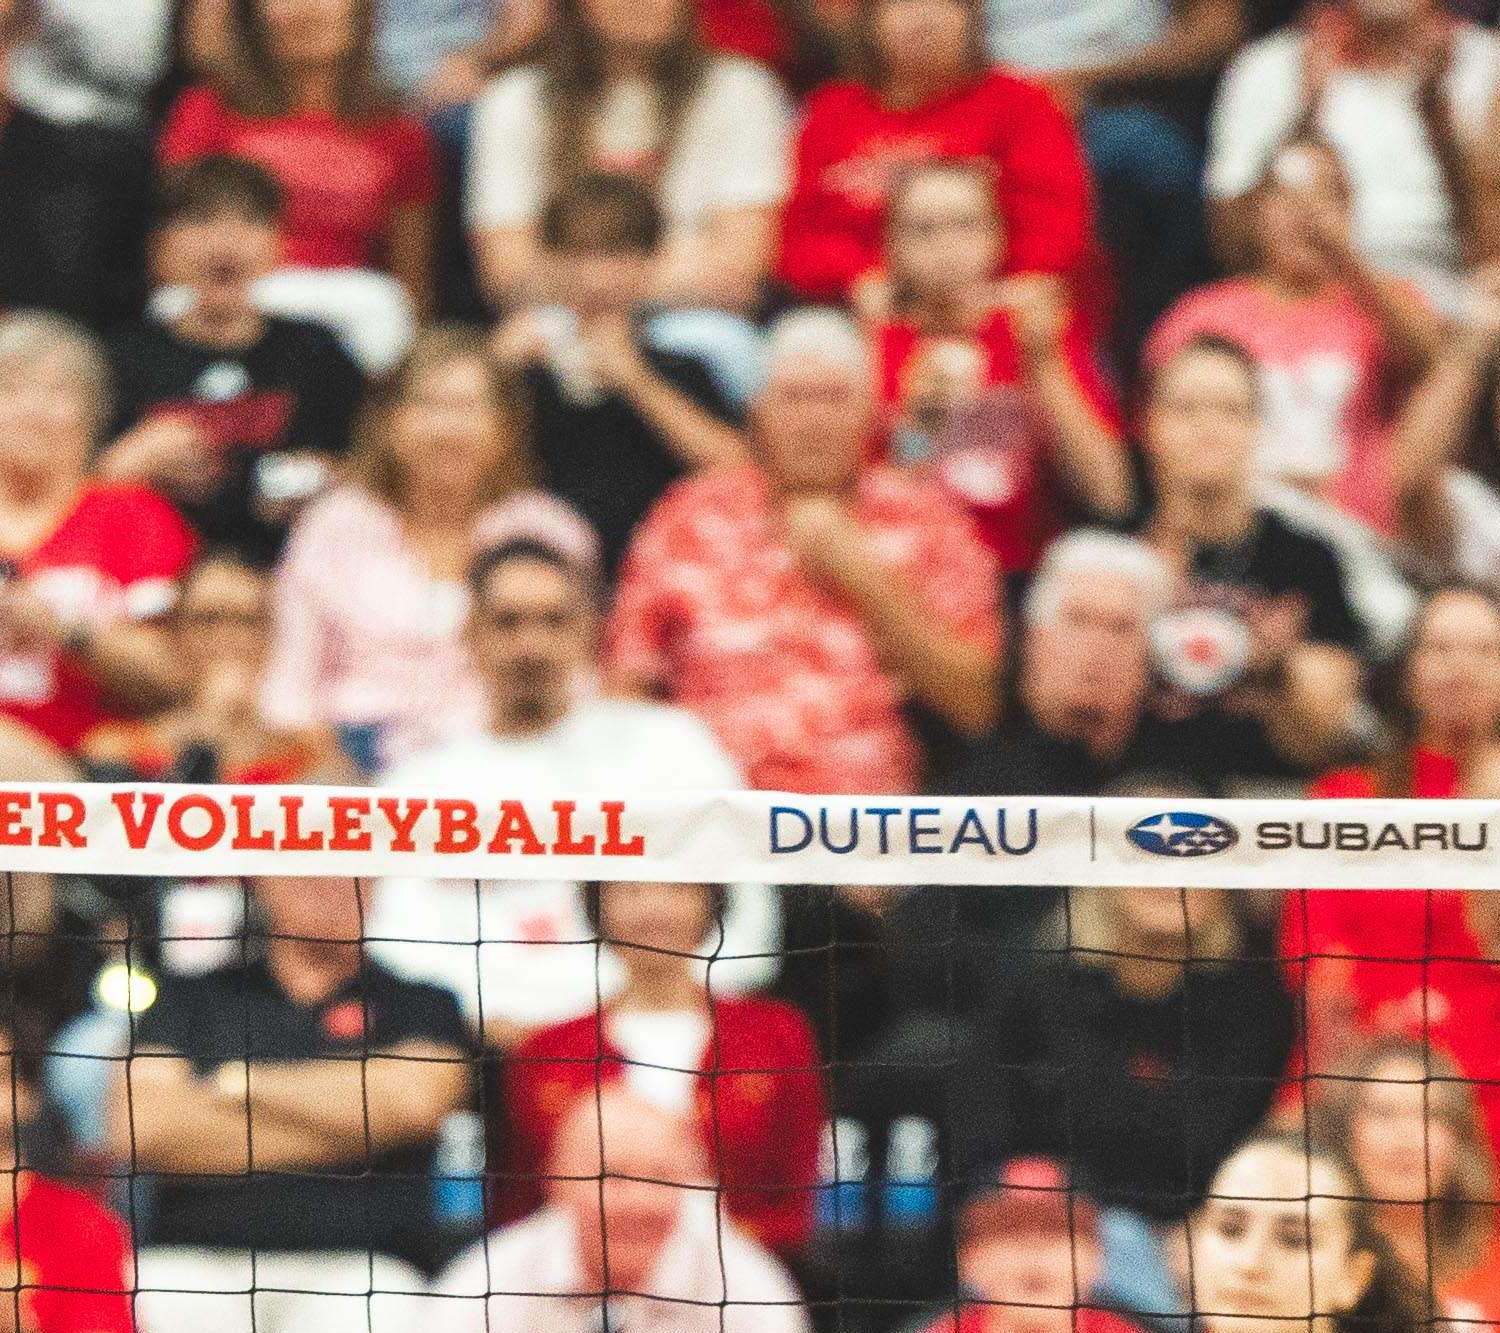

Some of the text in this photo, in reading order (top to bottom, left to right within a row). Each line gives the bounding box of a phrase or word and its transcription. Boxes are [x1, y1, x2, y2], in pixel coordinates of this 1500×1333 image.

[111, 790, 645, 857] VOLLEYBALL
[769, 807, 1040, 856] DUTEAU
[1256, 821, 1490, 852] SUBARU
